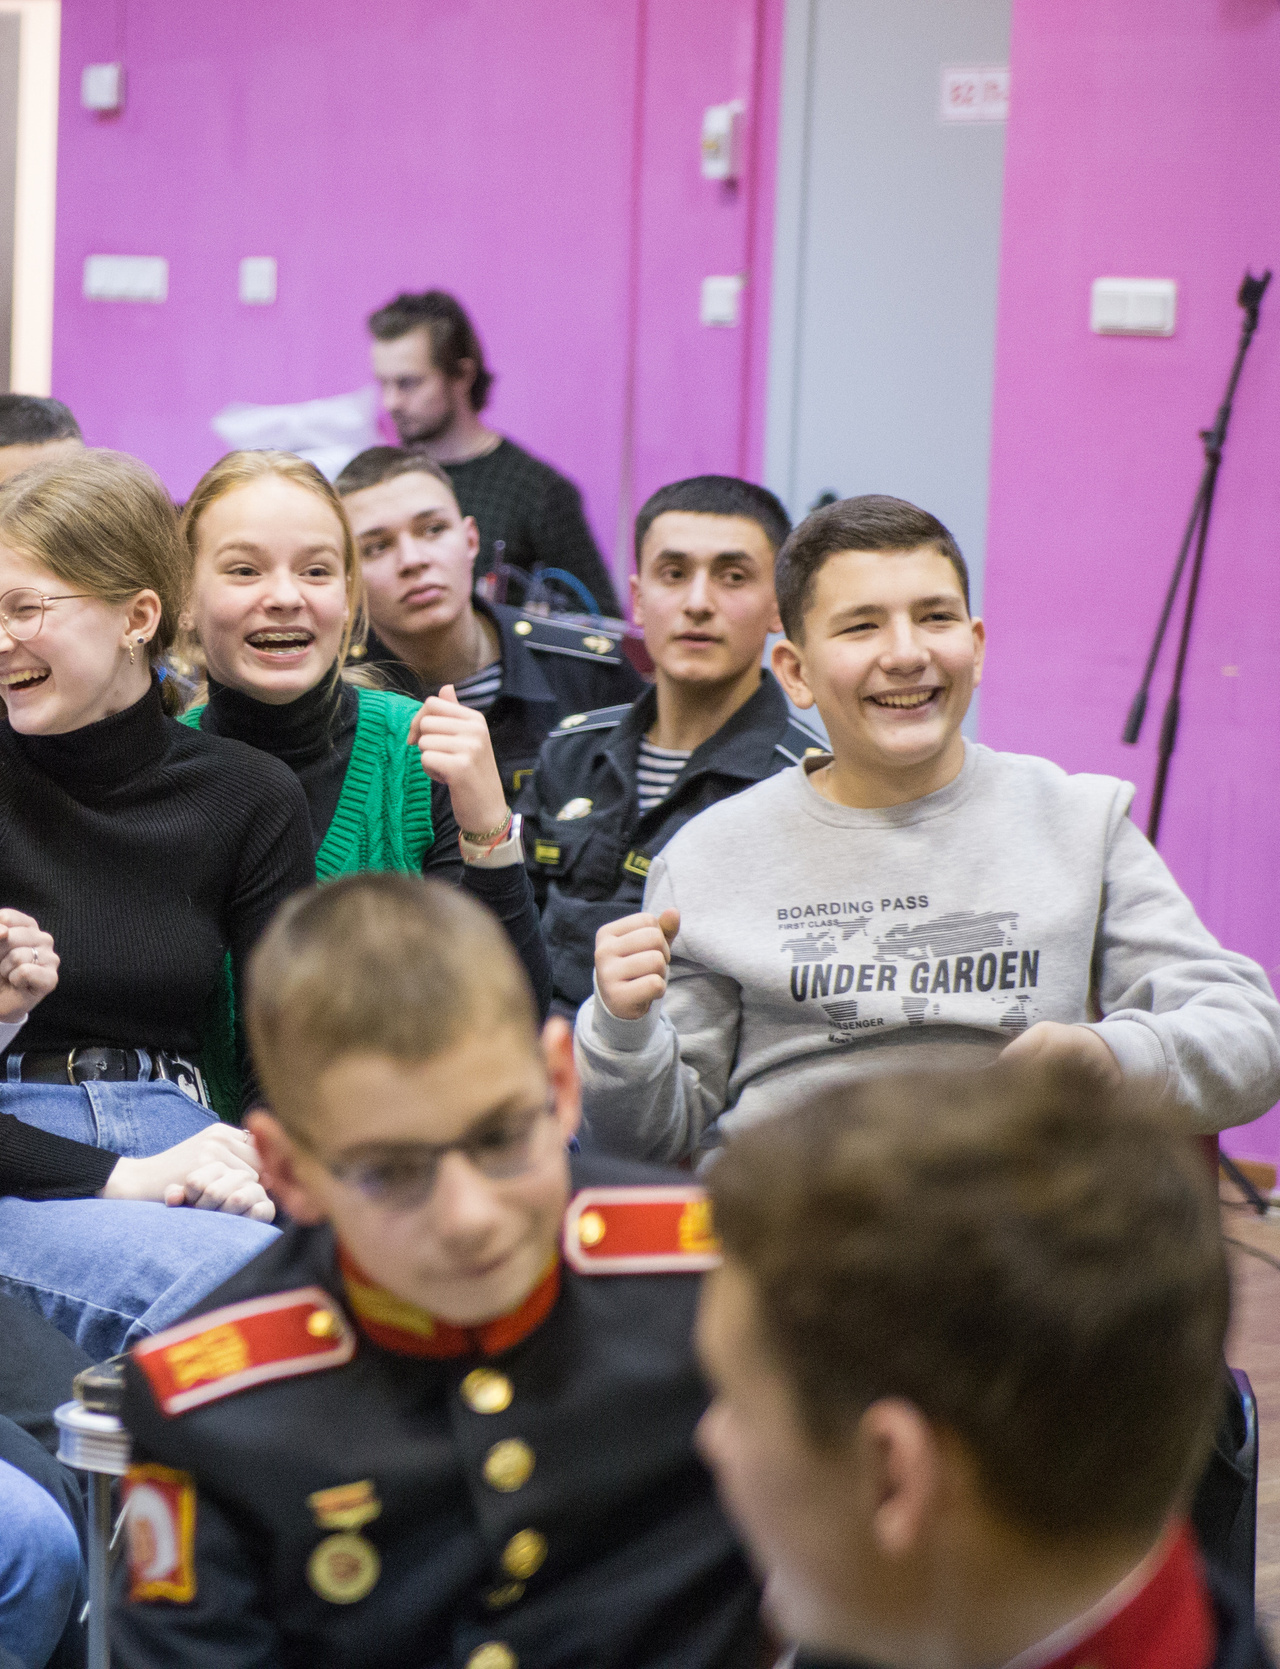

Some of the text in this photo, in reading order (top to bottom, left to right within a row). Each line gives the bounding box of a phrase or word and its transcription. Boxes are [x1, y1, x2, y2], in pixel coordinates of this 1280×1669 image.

[777, 895, 929, 920] BOARDING PASS
[778, 919, 839, 930] FIRST CLASS
[790, 963, 898, 1002] UNDER
